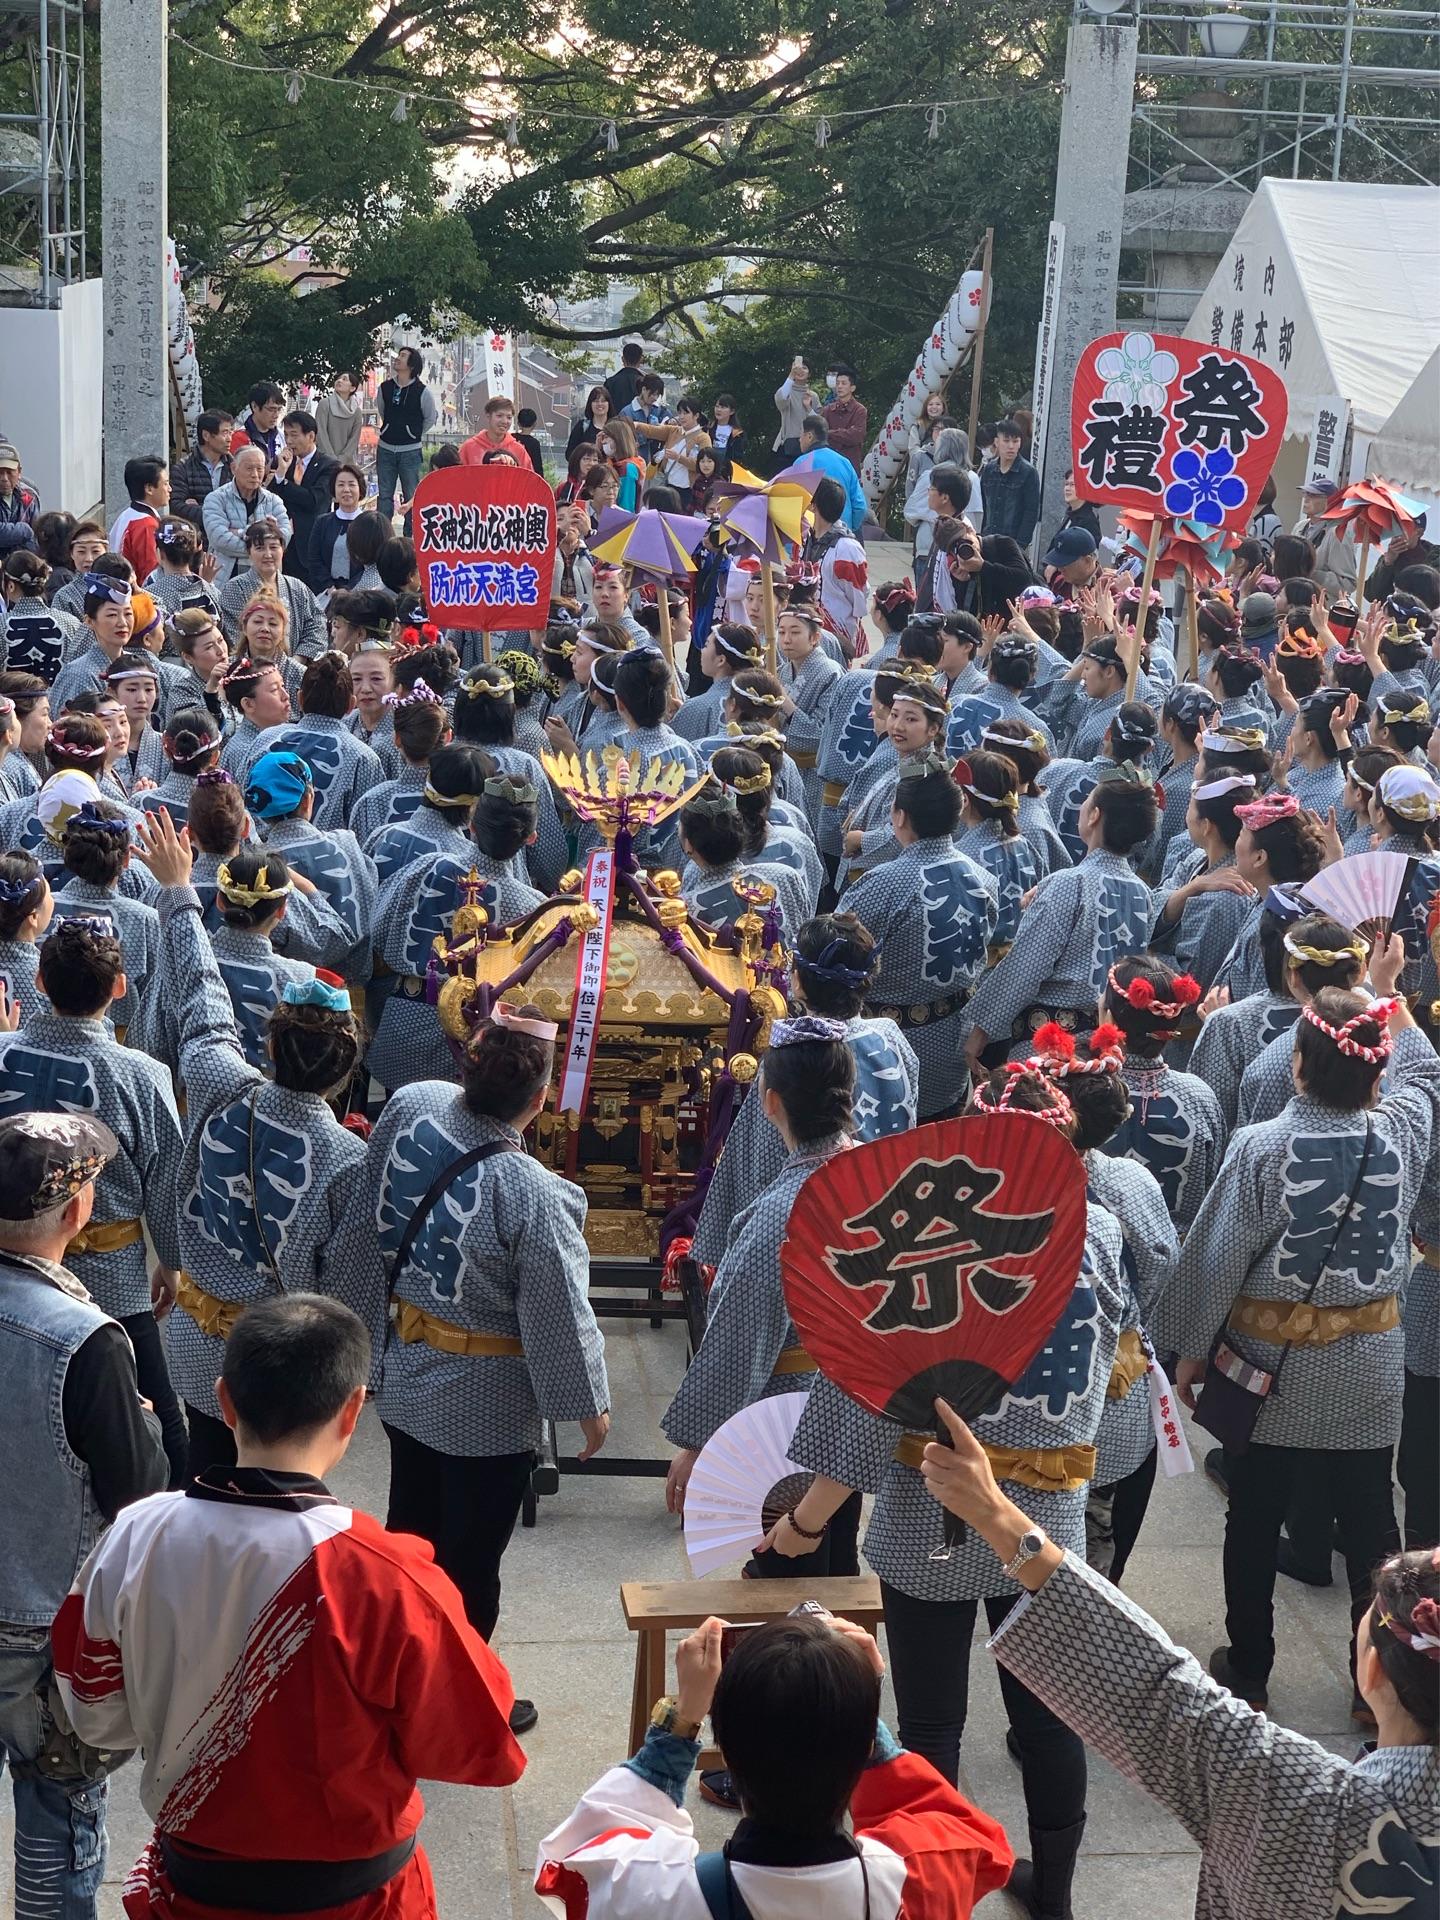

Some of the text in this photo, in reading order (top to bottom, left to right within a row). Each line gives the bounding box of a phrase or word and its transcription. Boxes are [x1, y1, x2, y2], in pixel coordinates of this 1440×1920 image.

[1233, 253, 1275, 297] 境内
[1211, 305, 1295, 371] 警備本部
[1172, 352, 1269, 456] 祭
[419, 502, 549, 554] 天神おんな神輿
[428, 560, 539, 607] 防府天満宮
[592, 859, 610, 889] 奉祝
[183, 1096, 313, 1274] 天神
[1274, 1131, 1404, 1291] 天神
[823, 1155, 1056, 1335] 祭
